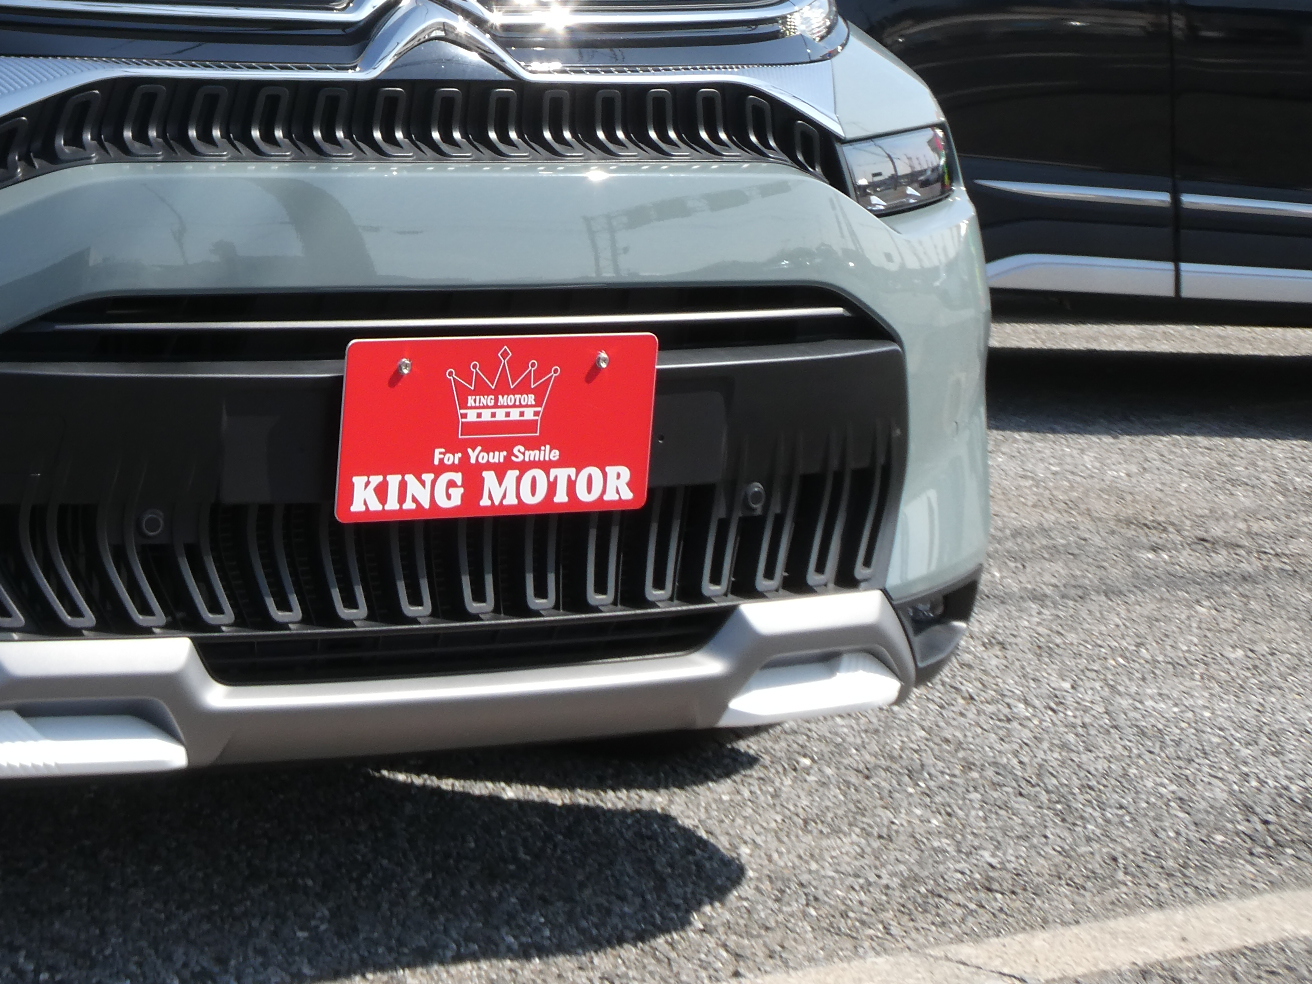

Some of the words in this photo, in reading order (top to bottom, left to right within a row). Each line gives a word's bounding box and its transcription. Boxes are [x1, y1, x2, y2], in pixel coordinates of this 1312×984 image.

[467, 394, 494, 406] KING
[498, 393, 535, 405] MOTOR
[434, 447, 462, 465] For
[468, 446, 507, 463] Your
[511, 444, 560, 462] Smile
[350, 472, 464, 512] KING
[479, 465, 633, 506] MOTOR
